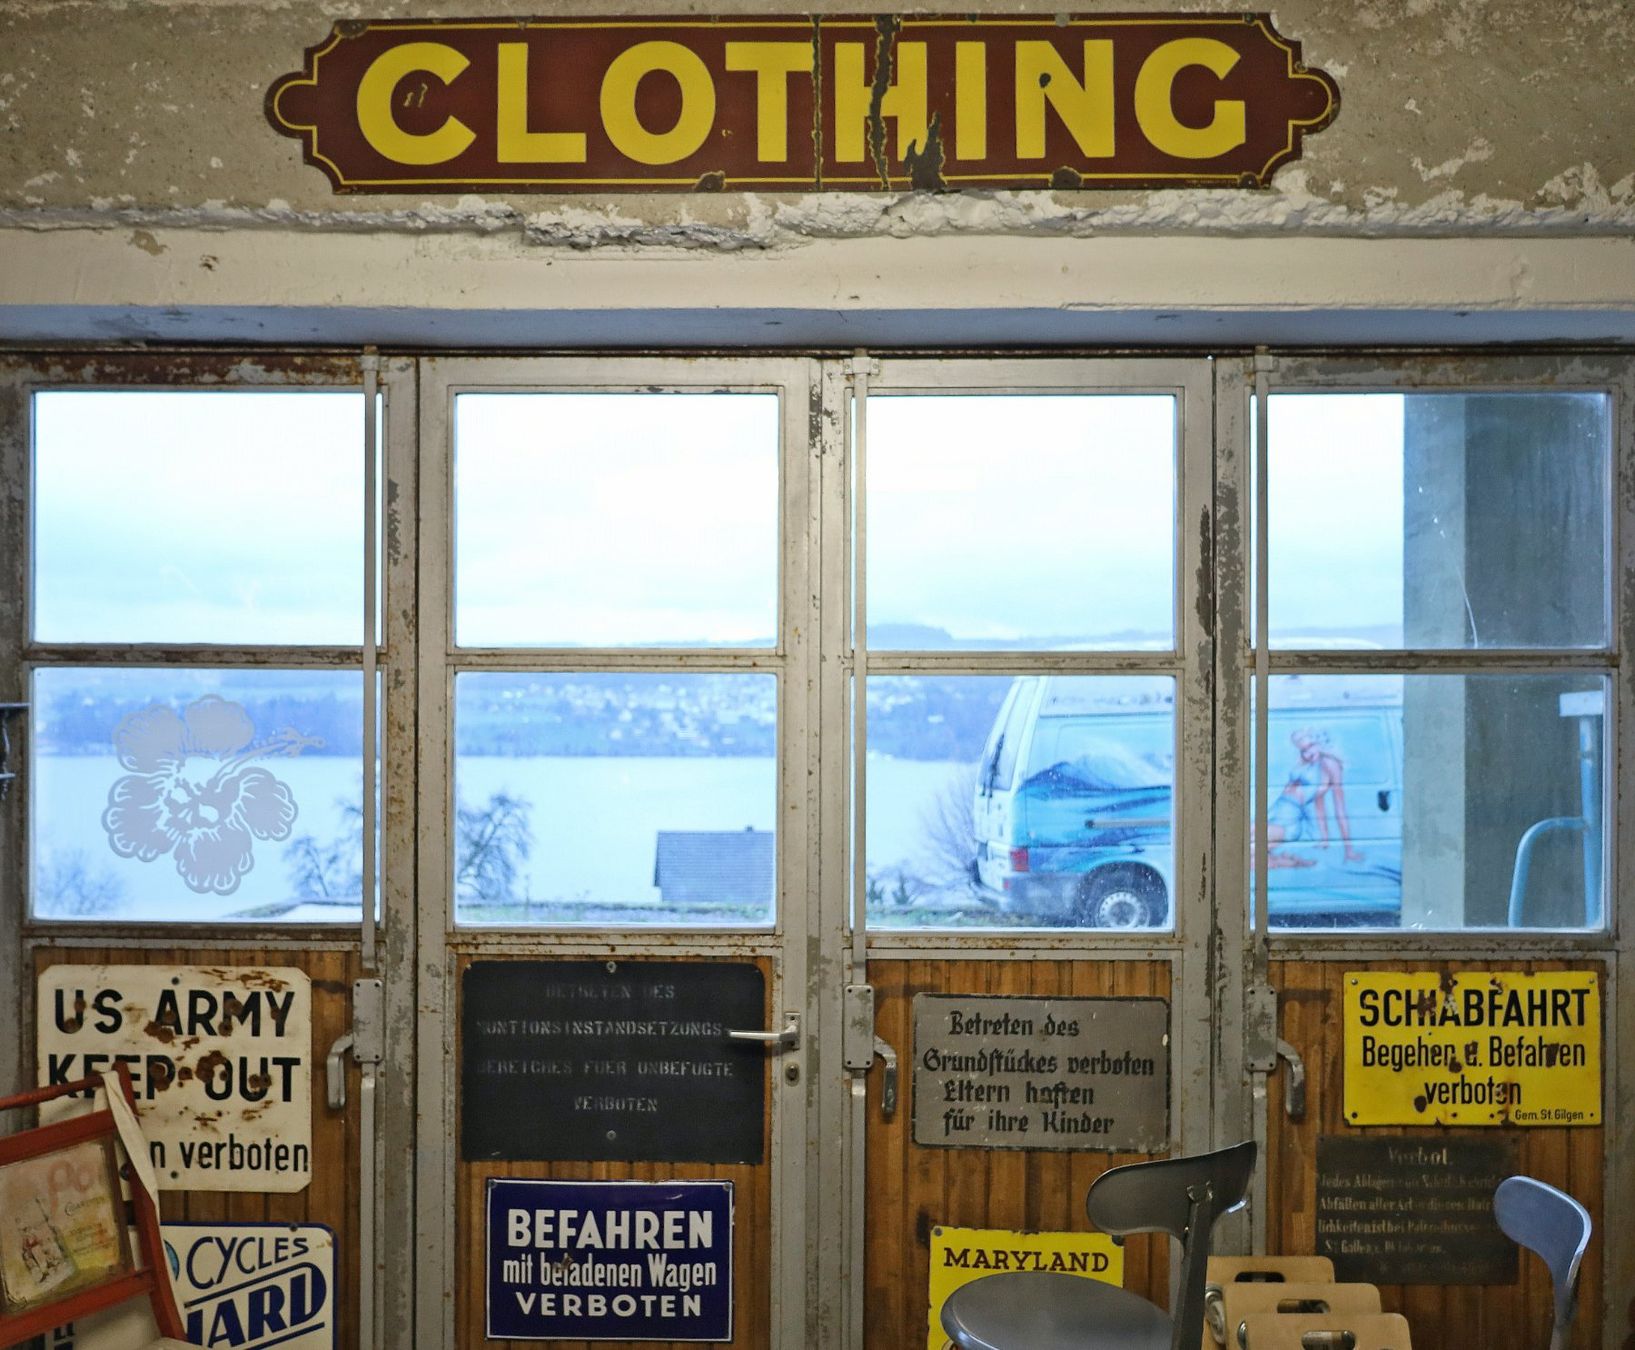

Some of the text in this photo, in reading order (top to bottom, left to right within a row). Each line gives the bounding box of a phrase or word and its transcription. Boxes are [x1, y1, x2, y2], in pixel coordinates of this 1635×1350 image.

[356, 38, 1247, 166] CLOTHING
[54, 989, 295, 1037] US ARMY
[948, 1010, 1080, 1036] Betreten des
[1068, 1050, 1154, 1076] verboten
[1362, 1036, 1456, 1072] Begehen
[1489, 1036, 1585, 1067] Befahen
[203, 1055, 301, 1102] OUT
[943, 1079, 1010, 1102] Eltern
[1424, 1074, 1521, 1105] verboten
[943, 1108, 1114, 1136] für ihre Kinder
[1555, 1109, 1584, 1122] Gilgen
[180, 1133, 309, 1172] verboten
[507, 1208, 713, 1250] BEFAHREN
[186, 1236, 309, 1290] CYCLES
[503, 1251, 717, 1293] mit beladenen Wagen
[943, 1247, 1109, 1272] MARYLAND
[516, 1292, 701, 1317] VERBOTEN
